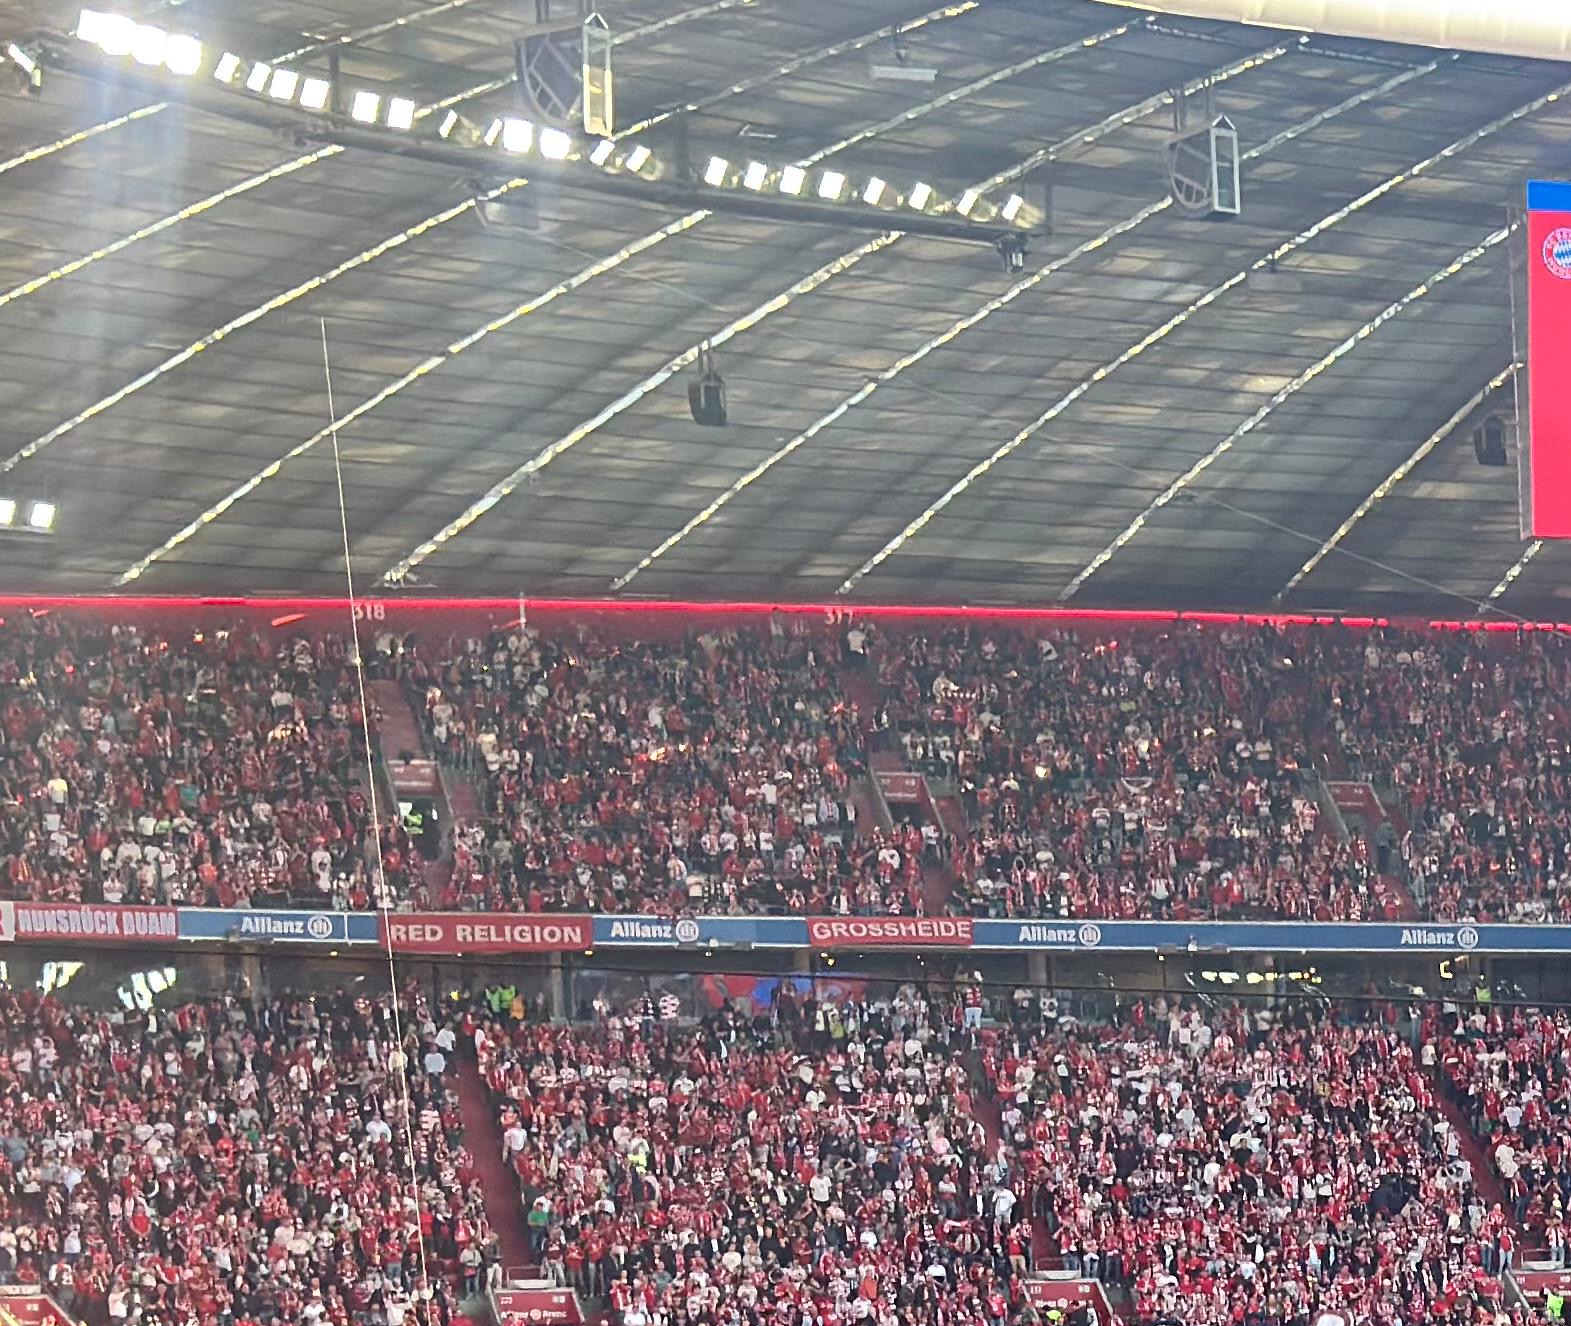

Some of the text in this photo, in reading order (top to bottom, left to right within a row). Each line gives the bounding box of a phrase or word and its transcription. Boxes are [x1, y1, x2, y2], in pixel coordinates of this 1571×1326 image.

[240, 915, 304, 934] Allianz
[390, 923, 583, 944] RED RELIGION
[610, 920, 672, 939] Allianz
[812, 920, 972, 940] GROSSHEIDE
[1019, 925, 1076, 943] Allianz
[1401, 928, 1455, 946] Allianz
